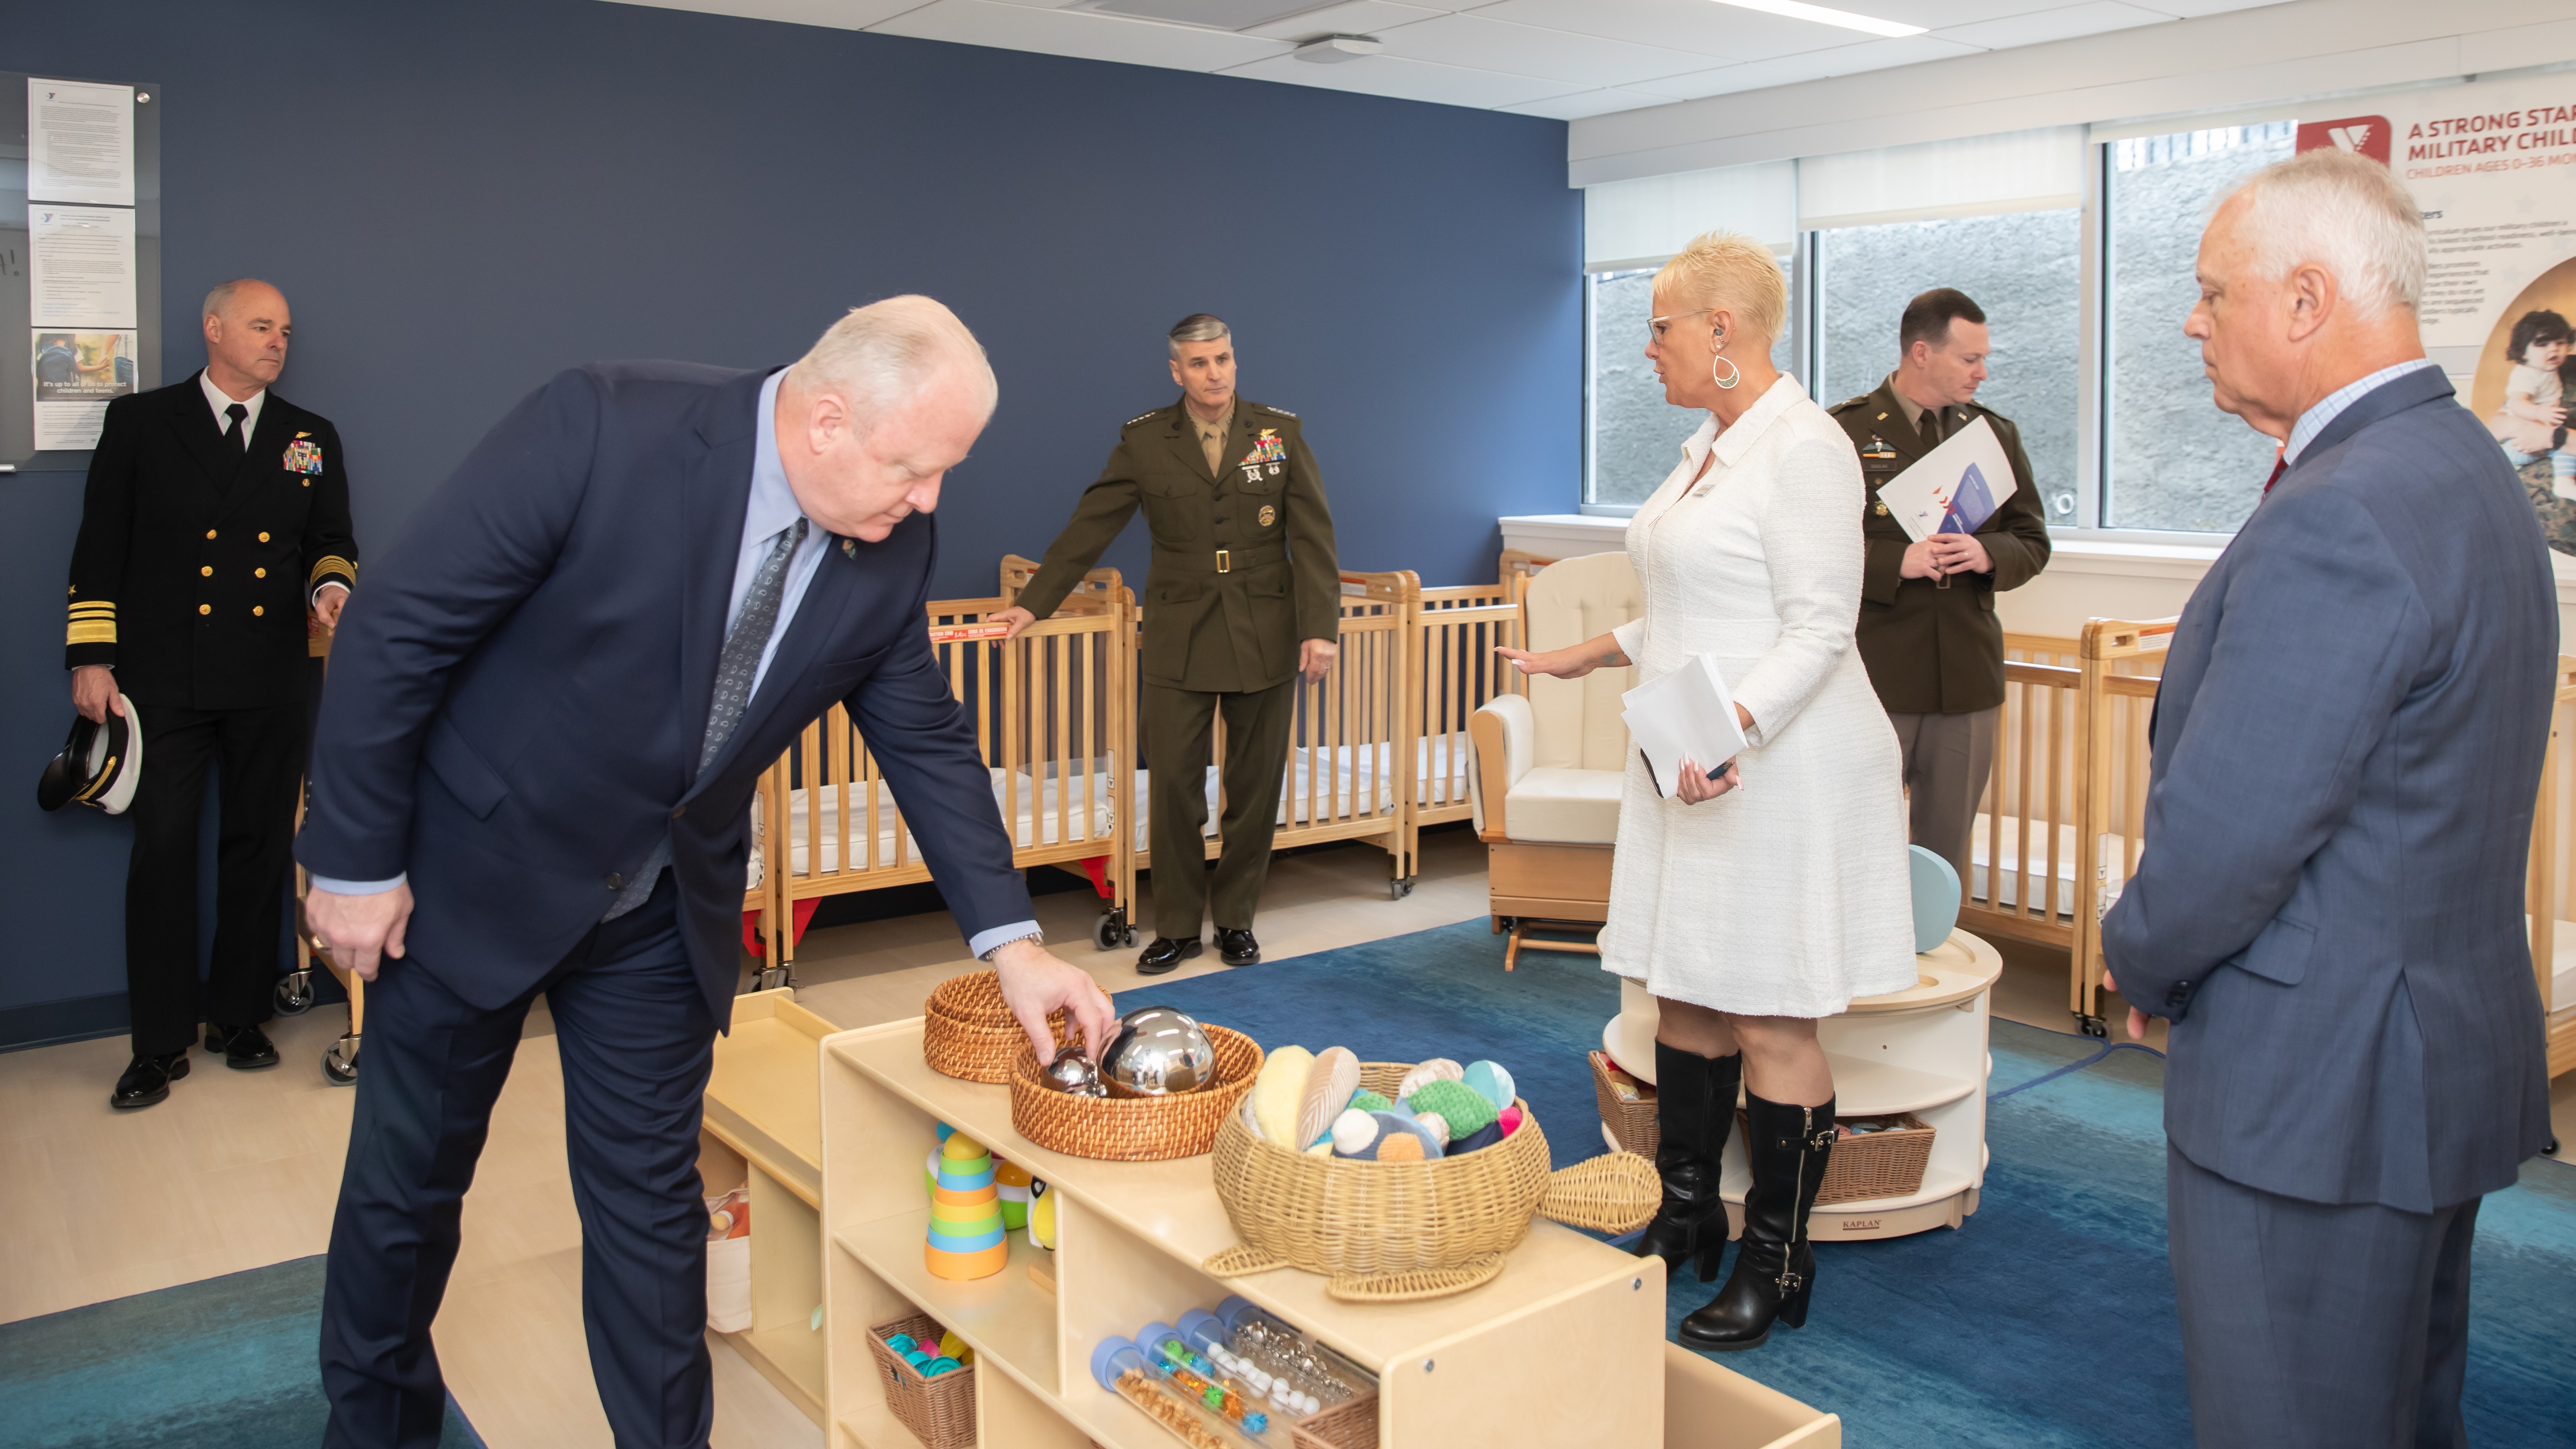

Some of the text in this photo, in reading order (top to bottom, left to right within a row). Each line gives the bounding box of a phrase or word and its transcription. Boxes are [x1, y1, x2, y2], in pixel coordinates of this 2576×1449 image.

[2408, 123, 2423, 139] A
[2428, 111, 2521, 138] STRONG
[2407, 135, 2512, 161] MILITARY
[2406, 163, 2472, 179] CHILDREN
[2475, 159, 2509, 173] AGES
